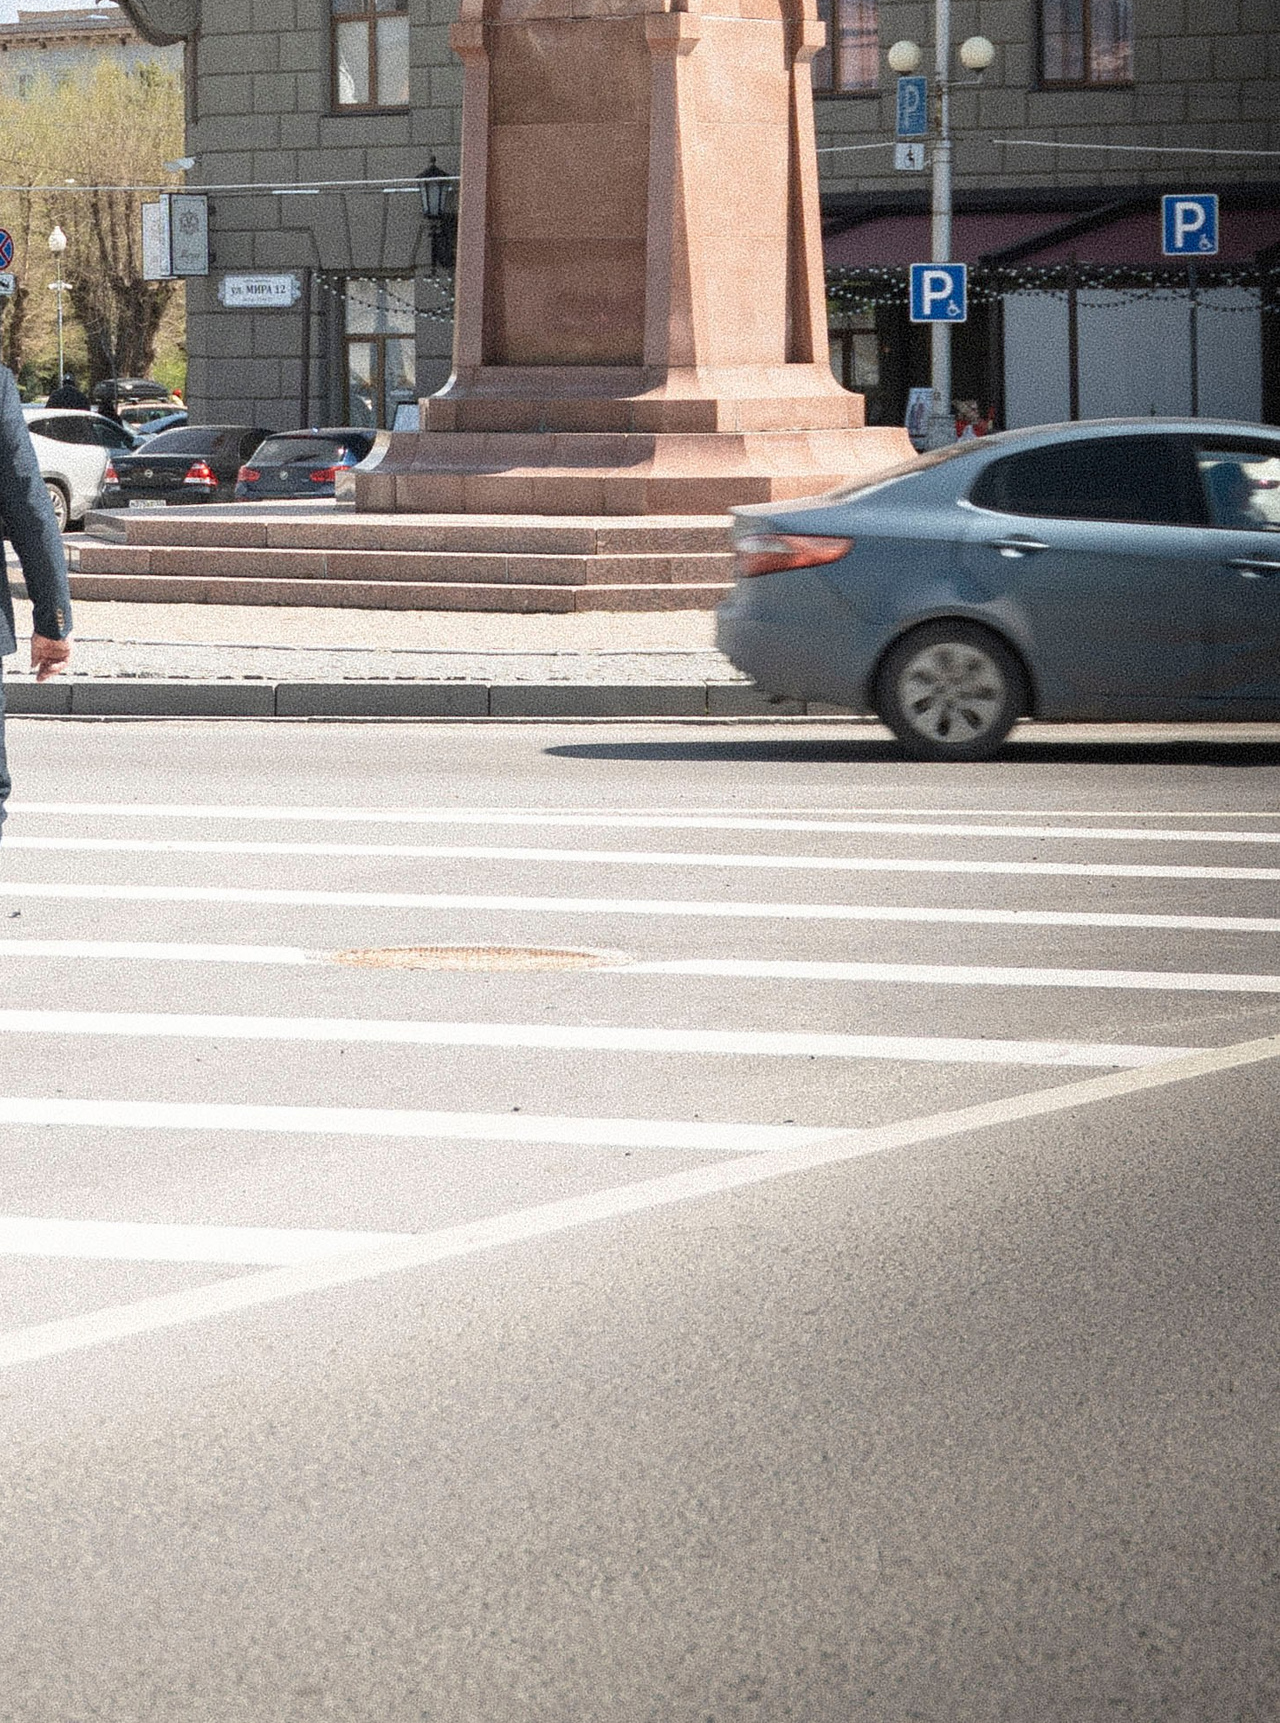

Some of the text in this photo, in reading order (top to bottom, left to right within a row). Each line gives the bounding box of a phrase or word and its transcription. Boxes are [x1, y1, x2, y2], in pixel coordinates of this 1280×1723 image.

[1174, 201, 1206, 248] P
[246, 284, 272, 294] МИРА
[274, 284, 287, 294] 12
[922, 269, 954, 315] P
